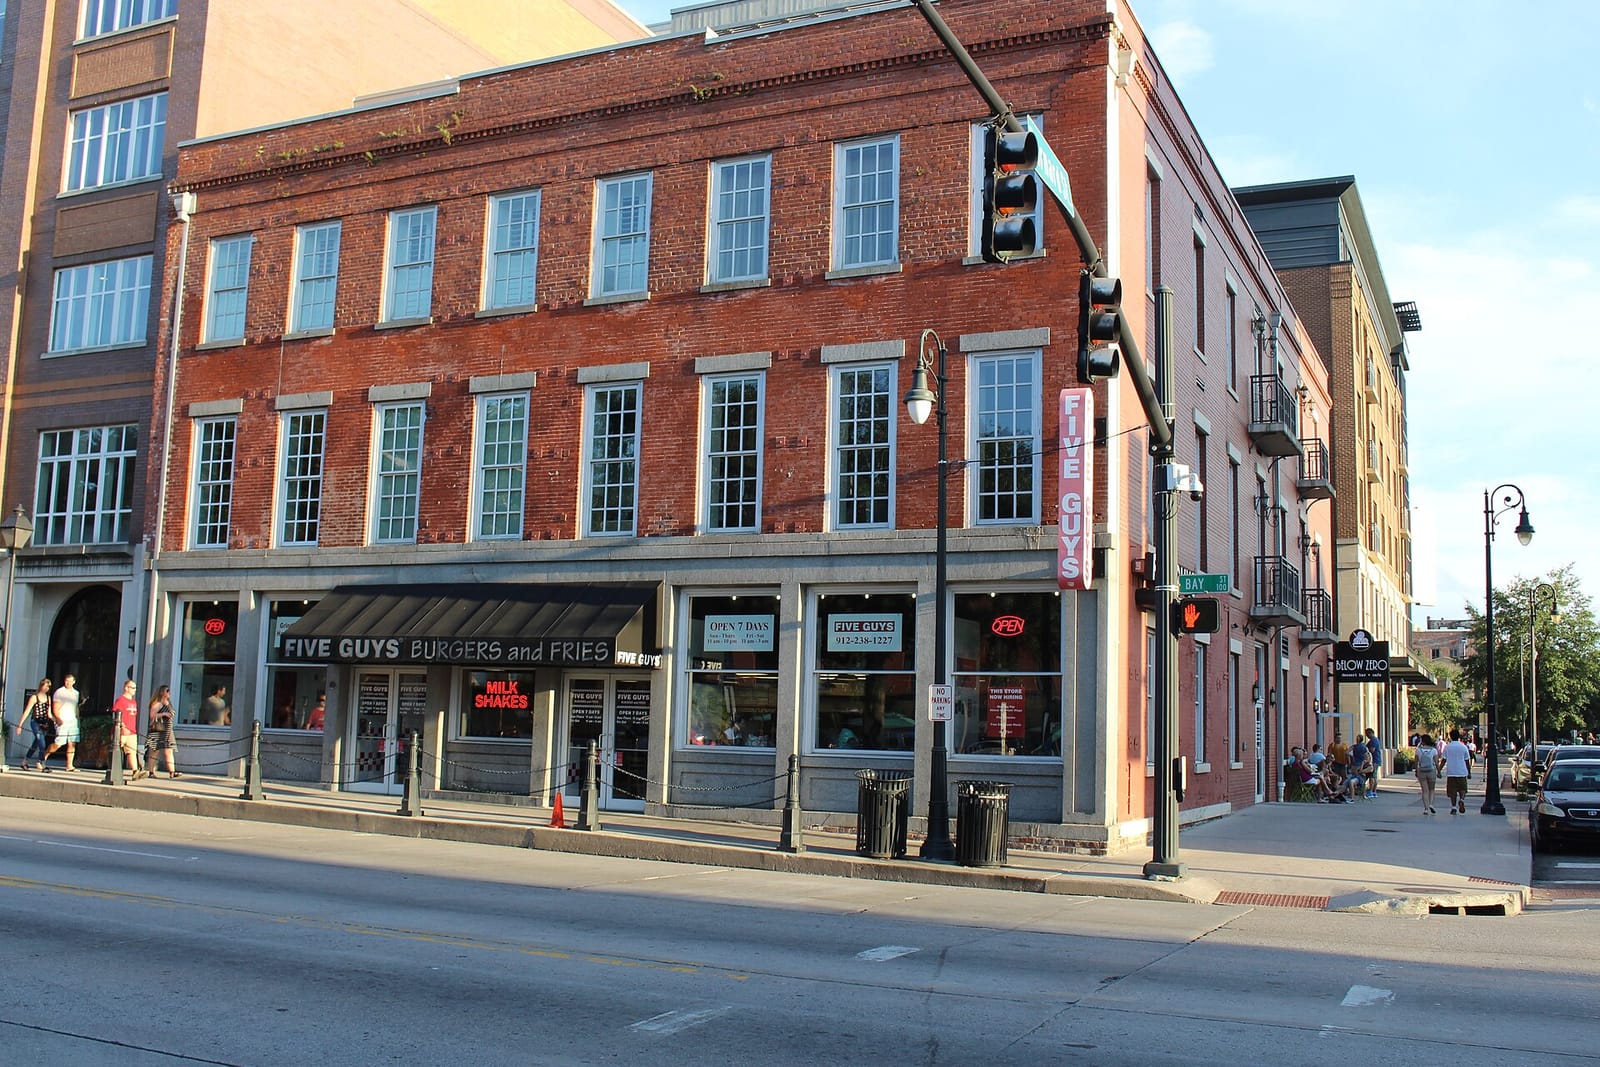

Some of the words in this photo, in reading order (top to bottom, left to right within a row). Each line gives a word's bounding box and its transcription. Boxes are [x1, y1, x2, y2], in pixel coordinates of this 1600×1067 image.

[1063, 395, 1081, 479] FIVE
[1061, 492, 1081, 579] GUYS
[1185, 578, 1204, 590] BAY
[1216, 583, 1227, 592] 100
[206, 619, 225, 633] OPEN
[710, 621, 735, 631] OPEN
[738, 622, 744, 631] 7
[746, 622, 769, 631] DAYS
[835, 622, 860, 631] FIVE
[863, 622, 894, 631] GUYS
[992, 618, 1024, 633] OPEN
[835, 636, 894, 645] 912-238-1227
[284, 638, 331, 657] FIVE
[338, 638, 400, 659] GUYS
[411, 640, 502, 660] BURGERS
[507, 641, 543, 661] and
[550, 641, 609, 661] FRIES
[616, 651, 637, 665] FIVE
[638, 653, 661, 667] GUYS
[1335, 659, 1363, 671] BELOW
[1365, 659, 1388, 671] ZERO
[486, 681, 518, 695] MILK
[936, 687, 946, 695] NO
[475, 694, 528, 709] SHAKES
